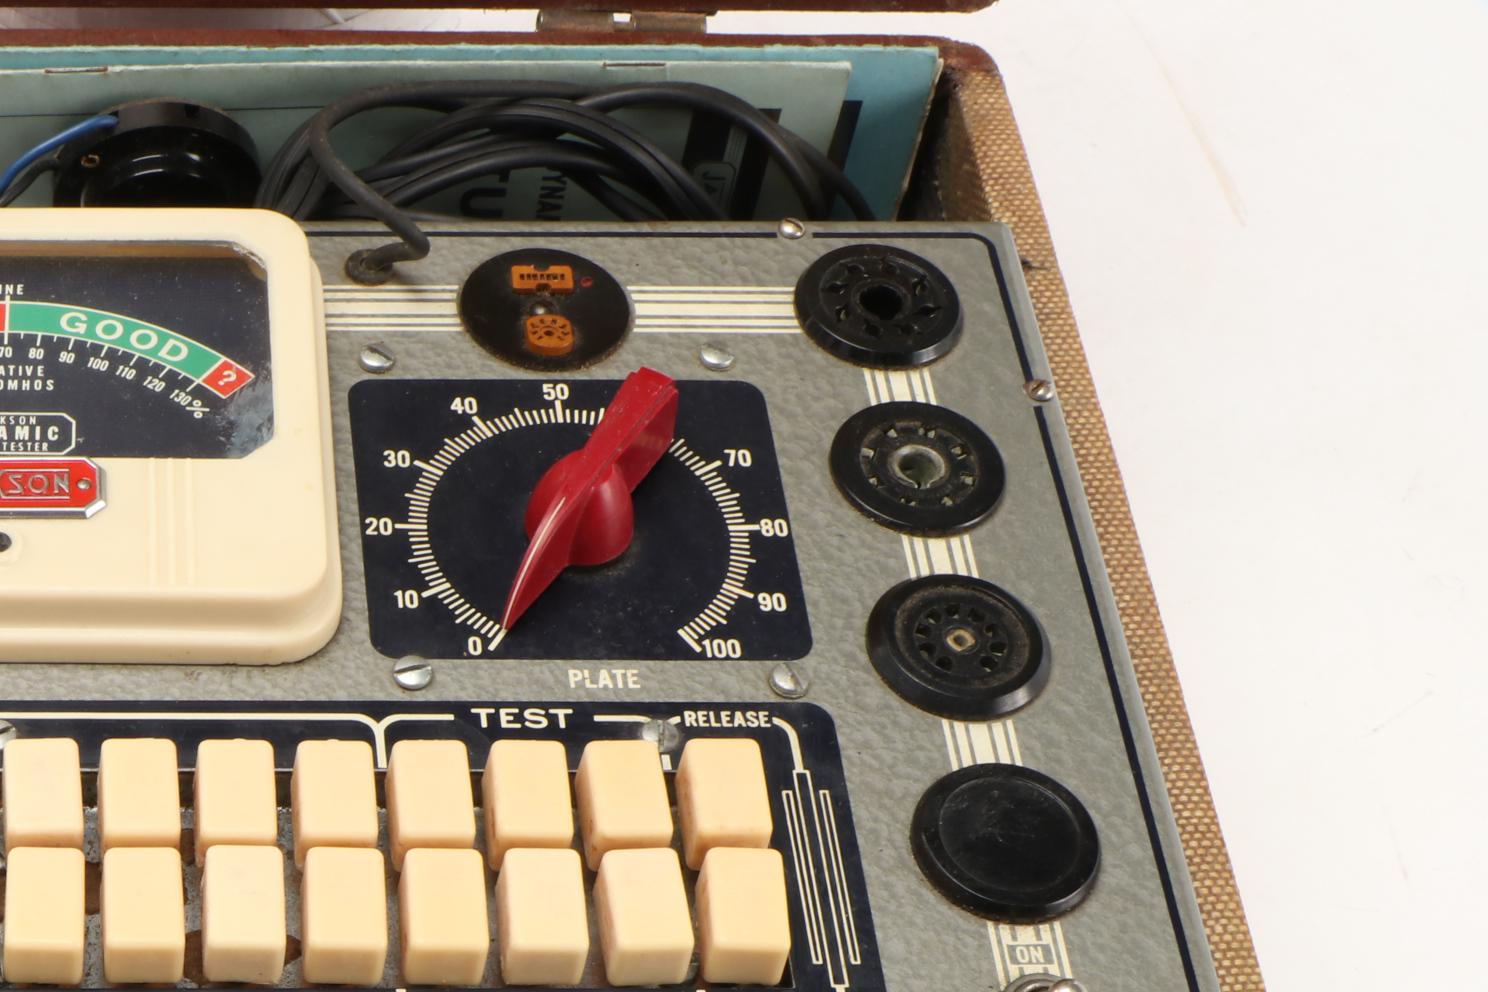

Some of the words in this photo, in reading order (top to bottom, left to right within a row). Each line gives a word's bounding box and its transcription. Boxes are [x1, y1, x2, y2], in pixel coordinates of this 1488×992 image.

[59, 311, 189, 365] GOOD
[28, 346, 45, 360] 80
[58, 350, 76, 364] 90
[86, 356, 110, 372] 100
[114, 365, 138, 381] 110
[142, 375, 166, 393] 120
[543, 384, 569, 400] 50
[450, 398, 477, 414] 40
[2, 442, 49, 452] TESTER
[383, 451, 410, 468] 30
[724, 450, 751, 467] 70
[365, 518, 393, 535] 20
[760, 519, 789, 537] 80
[393, 590, 419, 608] 10
[757, 593, 787, 611] 90
[467, 637, 482, 656] 0
[702, 640, 741, 659] 100
[568, 669, 641, 689] PLATE
[471, 708, 574, 729] TEST
[683, 710, 771, 728] RELEASE
[1016, 946, 1044, 963] ON
